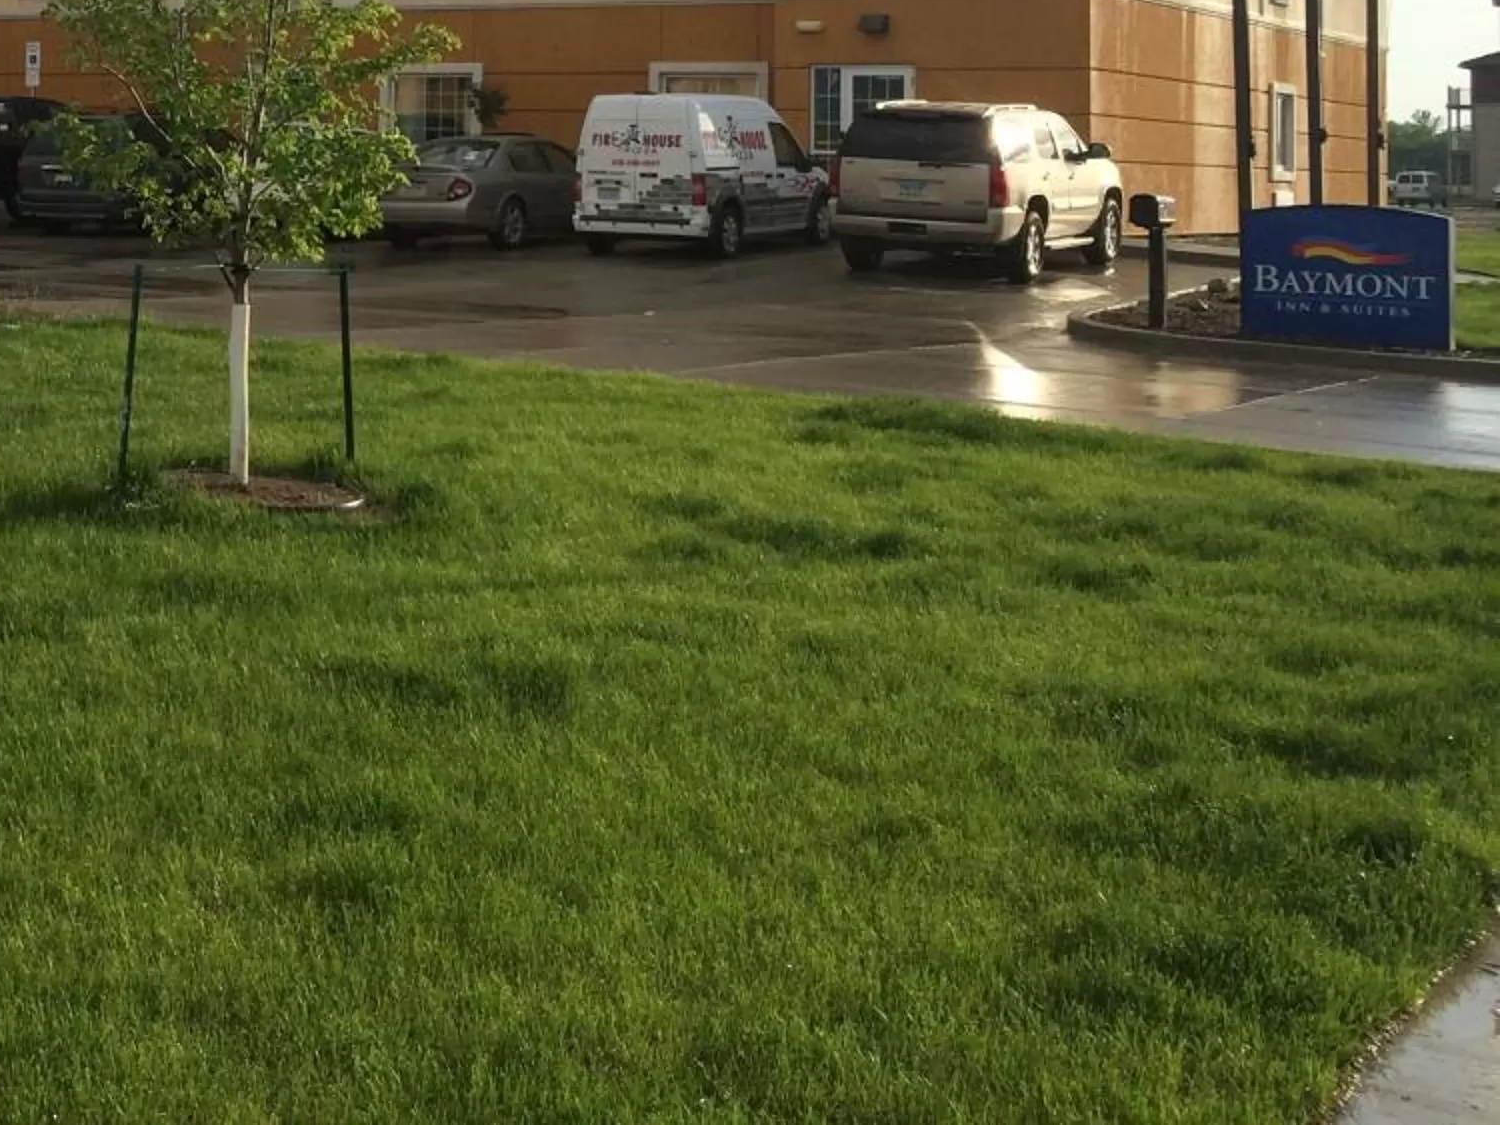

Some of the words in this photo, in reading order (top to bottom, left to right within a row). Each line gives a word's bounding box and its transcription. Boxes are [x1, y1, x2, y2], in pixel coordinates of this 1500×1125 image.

[642, 132, 684, 148] HOUSE
[1254, 264, 1436, 301] BAYMONT
[1277, 300, 1311, 313] INN
[1342, 304, 1411, 317] SUITES
